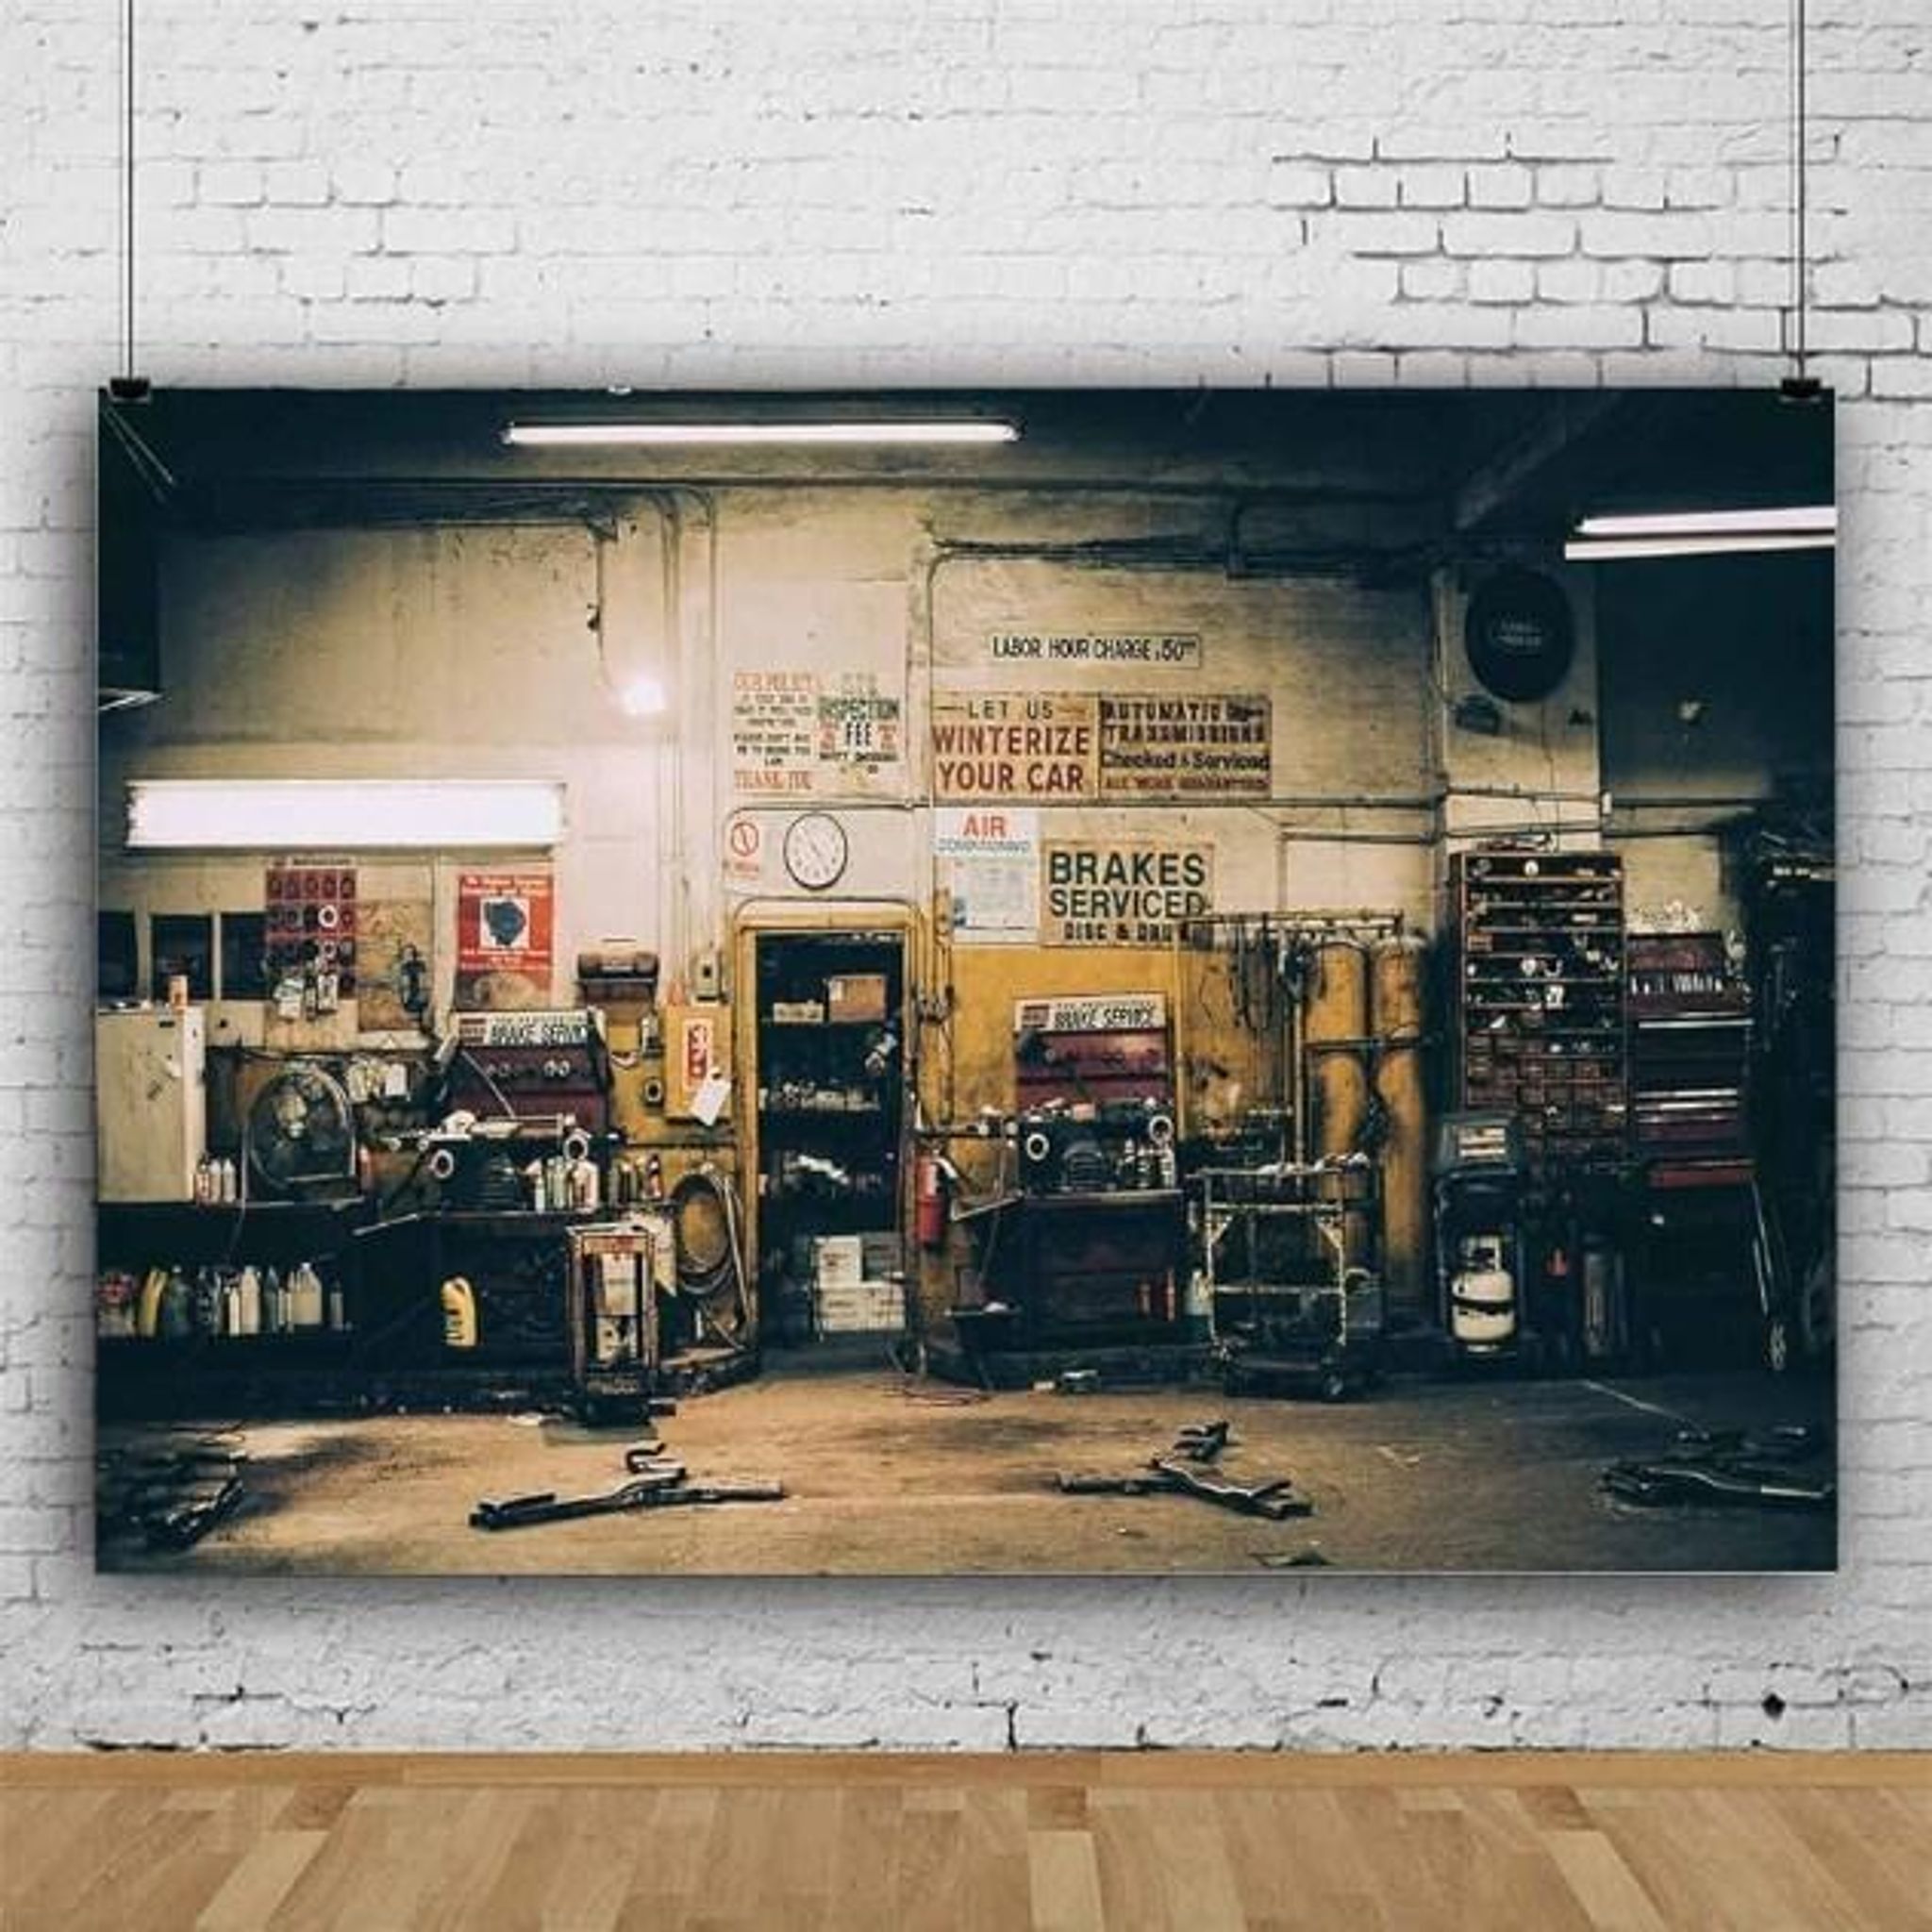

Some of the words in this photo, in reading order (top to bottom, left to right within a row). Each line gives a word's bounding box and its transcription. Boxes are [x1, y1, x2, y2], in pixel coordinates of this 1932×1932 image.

[993, 636, 1040, 658] LABOR
[1049, 638, 1089, 658] HOUR
[1094, 639, 1151, 660] CHARGE
[969, 701, 1008, 720] LET
[1027, 701, 1053, 720] US
[1101, 702, 1222, 720] AUTOMATIC
[845, 721, 872, 746] FEE
[932, 725, 1090, 755] WINTERIZE
[1101, 724, 1265, 743] TRANSMISSIONS
[1102, 748, 1175, 769] Checked
[1192, 750, 1271, 770] Serviced
[939, 762, 1014, 791] YOUR
[1026, 762, 1084, 792] CAR
[963, 814, 1007, 838] AIR
[1049, 851, 1207, 888] BRAKES
[1049, 889, 1208, 919] SERVICED
[1064, 922, 1108, 941] DISC
[1116, 923, 1129, 941] &
